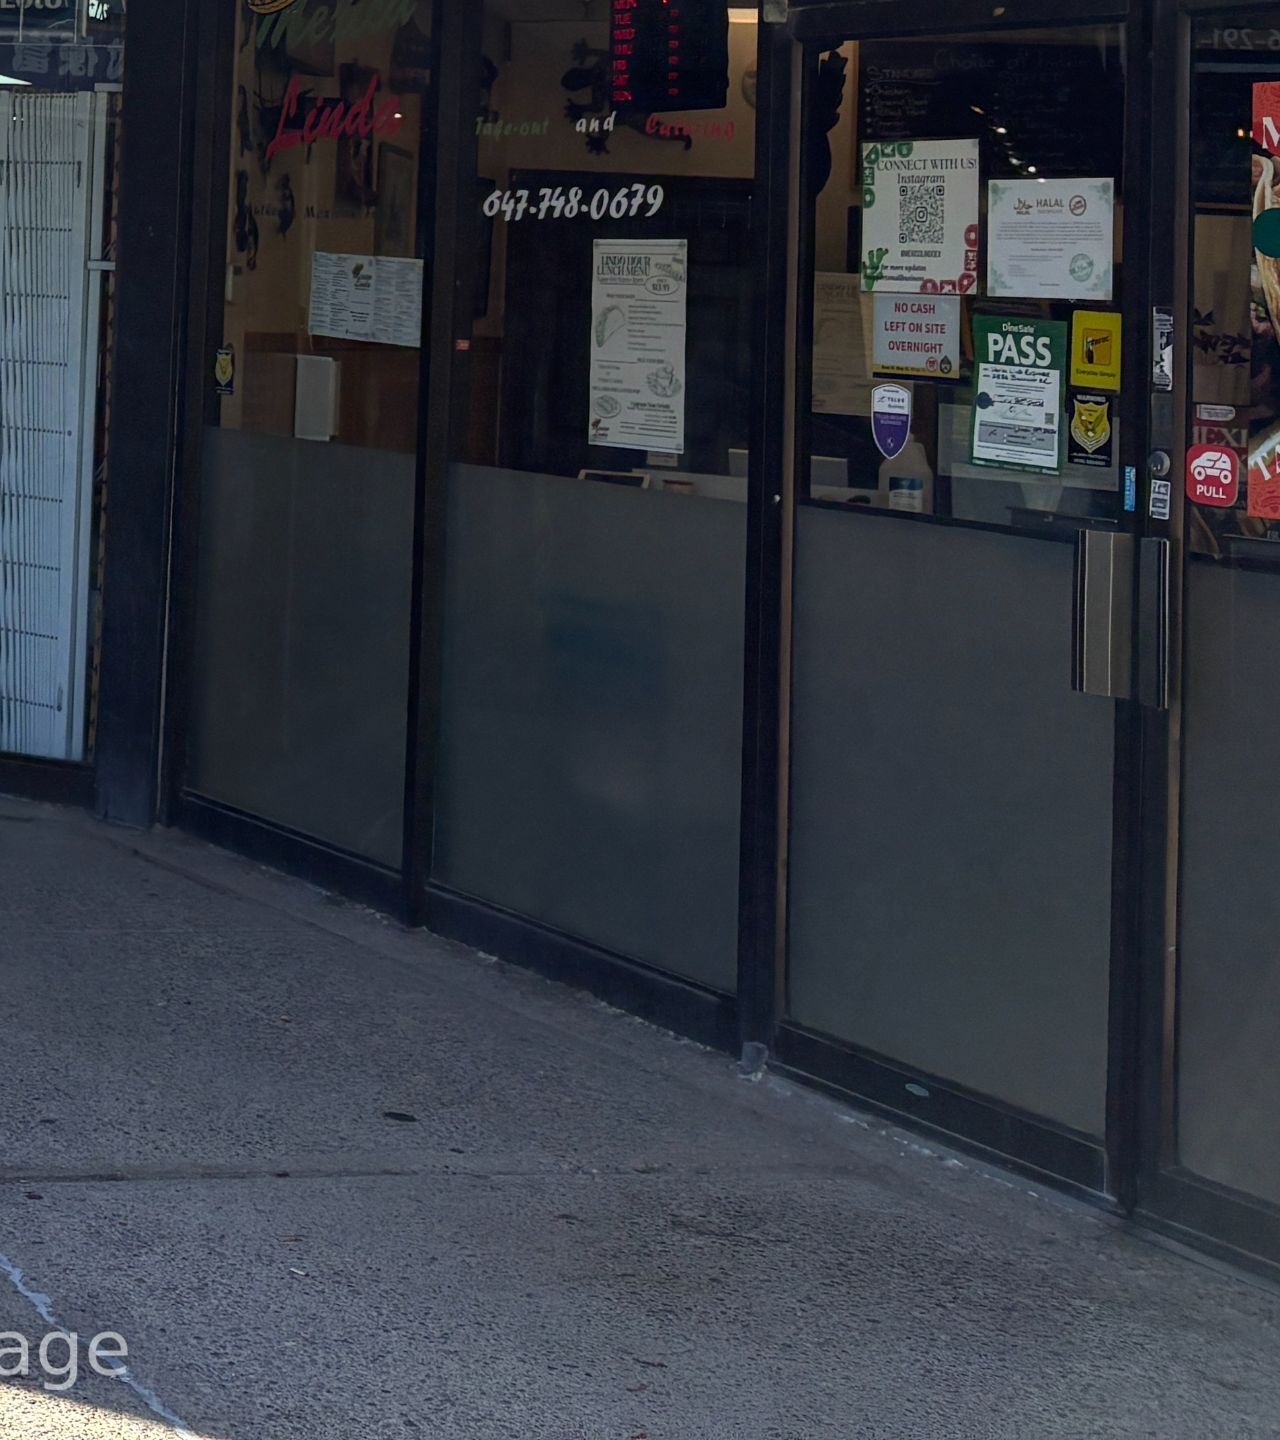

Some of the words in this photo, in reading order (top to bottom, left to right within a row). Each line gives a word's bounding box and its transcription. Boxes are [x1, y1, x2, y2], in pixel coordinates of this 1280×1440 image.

[575, 111, 617, 134] and
[645, 112, 735, 142] Catering
[877, 159, 929, 172] CONNECT
[931, 159, 960, 171] WITH
[960, 158, 977, 170] US!
[897, 173, 946, 186] Instagram
[1036, 197, 1065, 209] HALAL
[894, 302, 908, 313] NO
[910, 303, 936, 315] CASH
[884, 321, 907, 333] LEFT
[908, 322, 923, 334] ON
[925, 323, 946, 334] SITE
[888, 340, 943, 354] OVERNIGHT
[988, 333, 1052, 367] PASS
[1196, 484, 1227, 499] PULL
